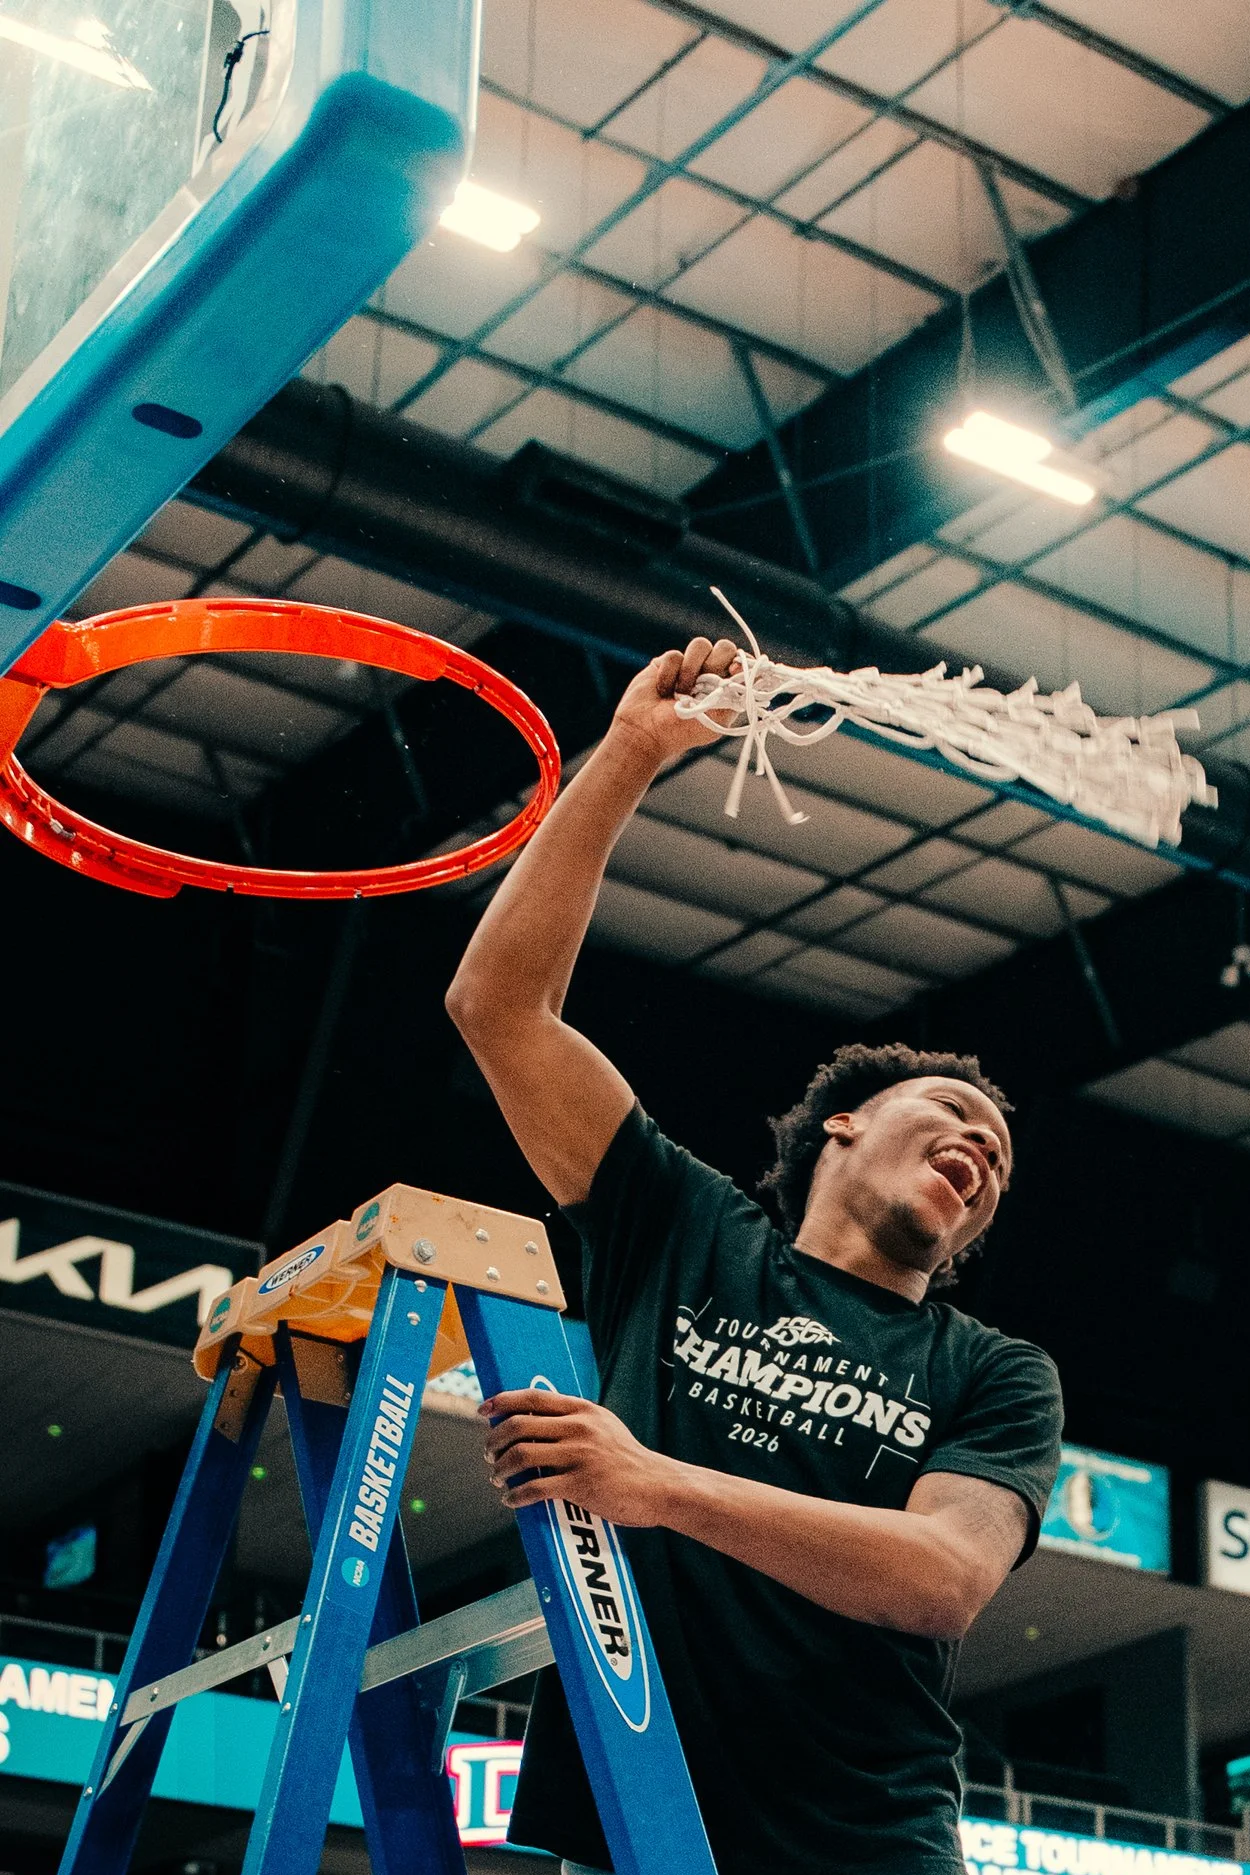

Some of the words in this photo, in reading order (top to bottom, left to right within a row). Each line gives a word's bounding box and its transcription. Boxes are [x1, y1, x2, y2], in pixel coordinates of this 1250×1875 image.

[269, 1254, 314, 1287] WERNER
[688, 1381, 845, 1447] BASKETBALL
[728, 1422, 780, 1453] 2026
[348, 1374, 415, 1552] BASKETBALL
[563, 1499, 630, 1659] ERNER
